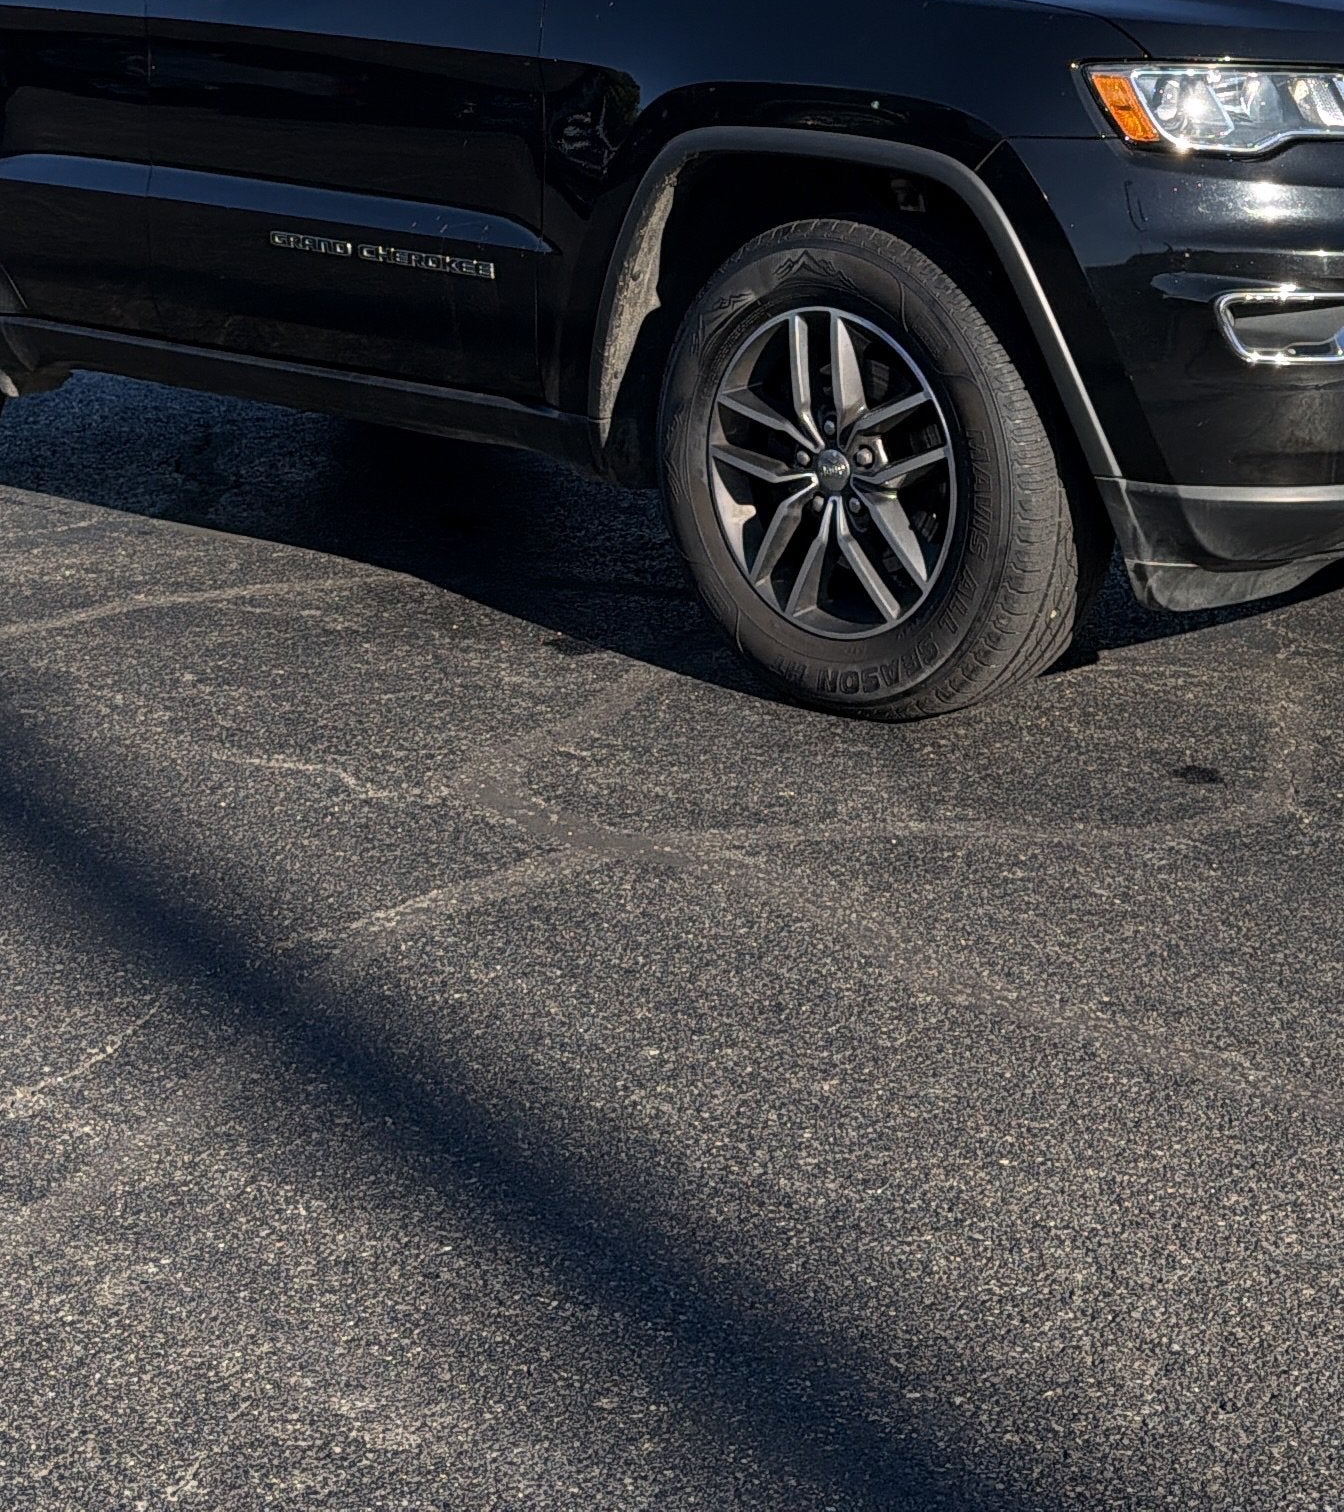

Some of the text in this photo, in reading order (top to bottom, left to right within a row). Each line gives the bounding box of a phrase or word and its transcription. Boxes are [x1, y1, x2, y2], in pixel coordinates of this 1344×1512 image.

[269, 230, 496, 280] GRAND CHEROKEE
[966, 428, 993, 561] MAVIS
[936, 564, 979, 635] ALL
